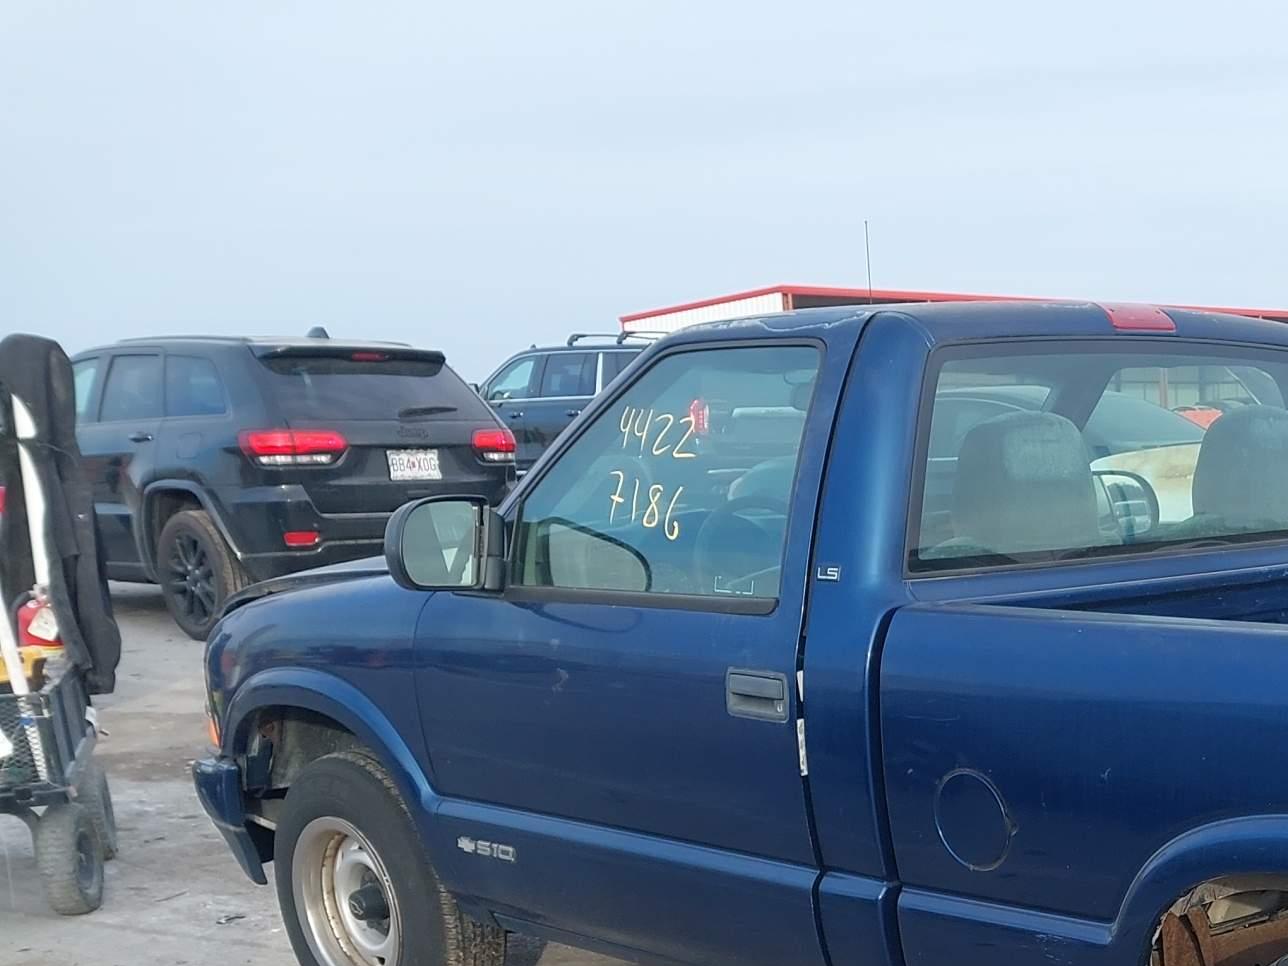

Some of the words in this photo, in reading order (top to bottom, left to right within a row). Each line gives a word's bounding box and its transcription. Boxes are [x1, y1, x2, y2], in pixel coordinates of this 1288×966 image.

[619, 405, 697, 459] 4422
[610, 470, 684, 541] 7186
[817, 567, 839, 580] LS
[476, 840, 516, 862] S10
